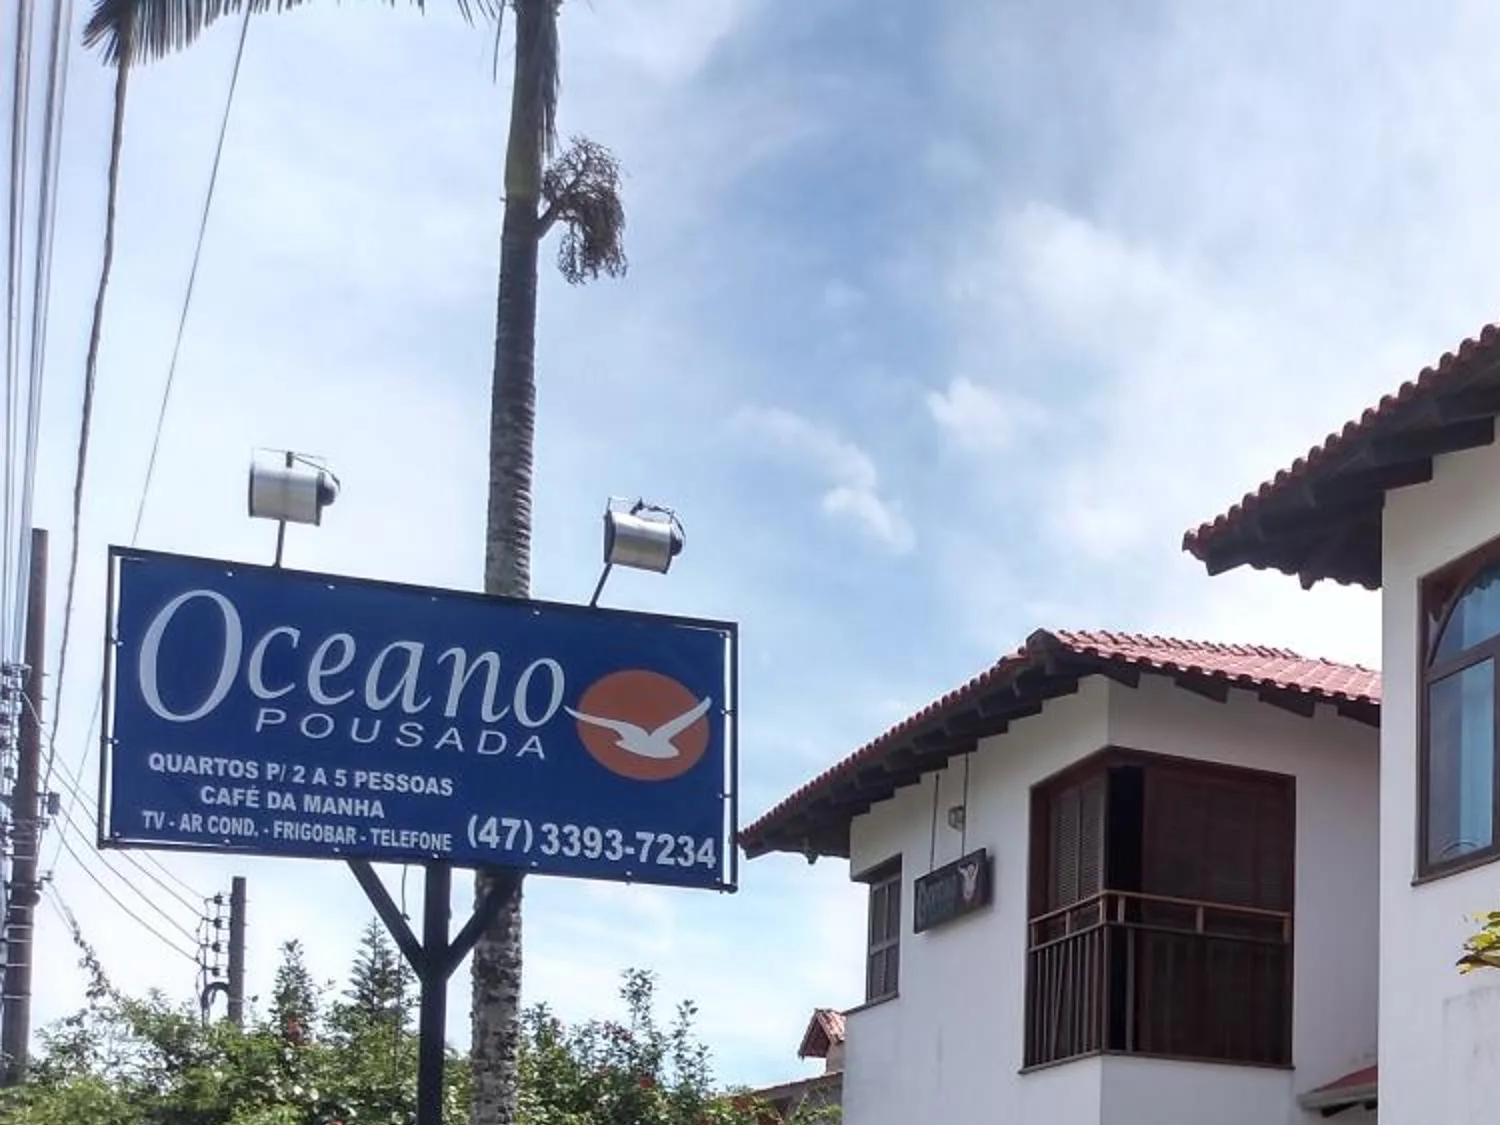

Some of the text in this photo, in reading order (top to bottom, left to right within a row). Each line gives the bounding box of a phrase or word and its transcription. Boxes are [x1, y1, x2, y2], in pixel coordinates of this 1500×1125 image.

[139, 589, 565, 728] Oceano
[255, 708, 546, 760] POUSADA
[148, 752, 453, 796] QUARTOS P/ 2 A 5 PESSOAS
[201, 785, 260, 809] CAFÉ
[267, 791, 297, 811] DA
[142, 810, 165, 830] TV
[179, 813, 203, 833] AR
[207, 815, 259, 837] COND.
[273, 821, 357, 845] FRIGOBAR
[370, 828, 453, 851] TELEFONE
[467, 814, 717, 869] (47) 3393-7234
